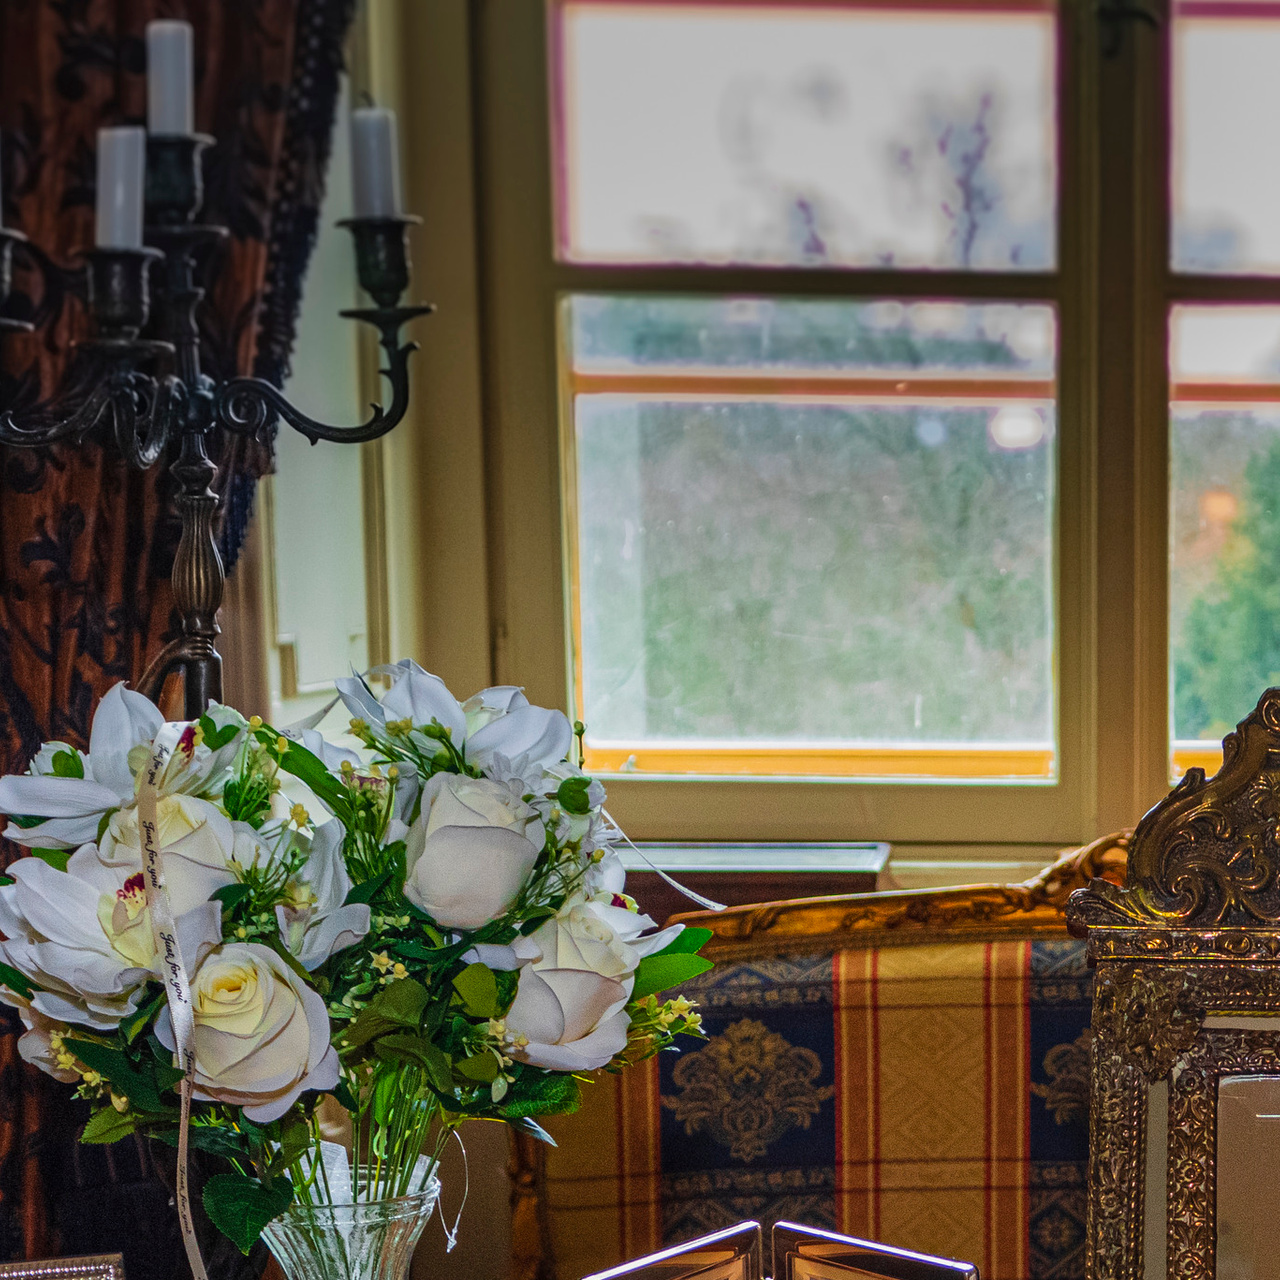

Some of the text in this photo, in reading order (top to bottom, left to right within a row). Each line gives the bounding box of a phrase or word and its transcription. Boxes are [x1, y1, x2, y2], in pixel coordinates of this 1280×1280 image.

[153, 756, 163, 769] for
[142, 821, 159, 888] Just for you
[160, 932, 184, 1003] Just for you
